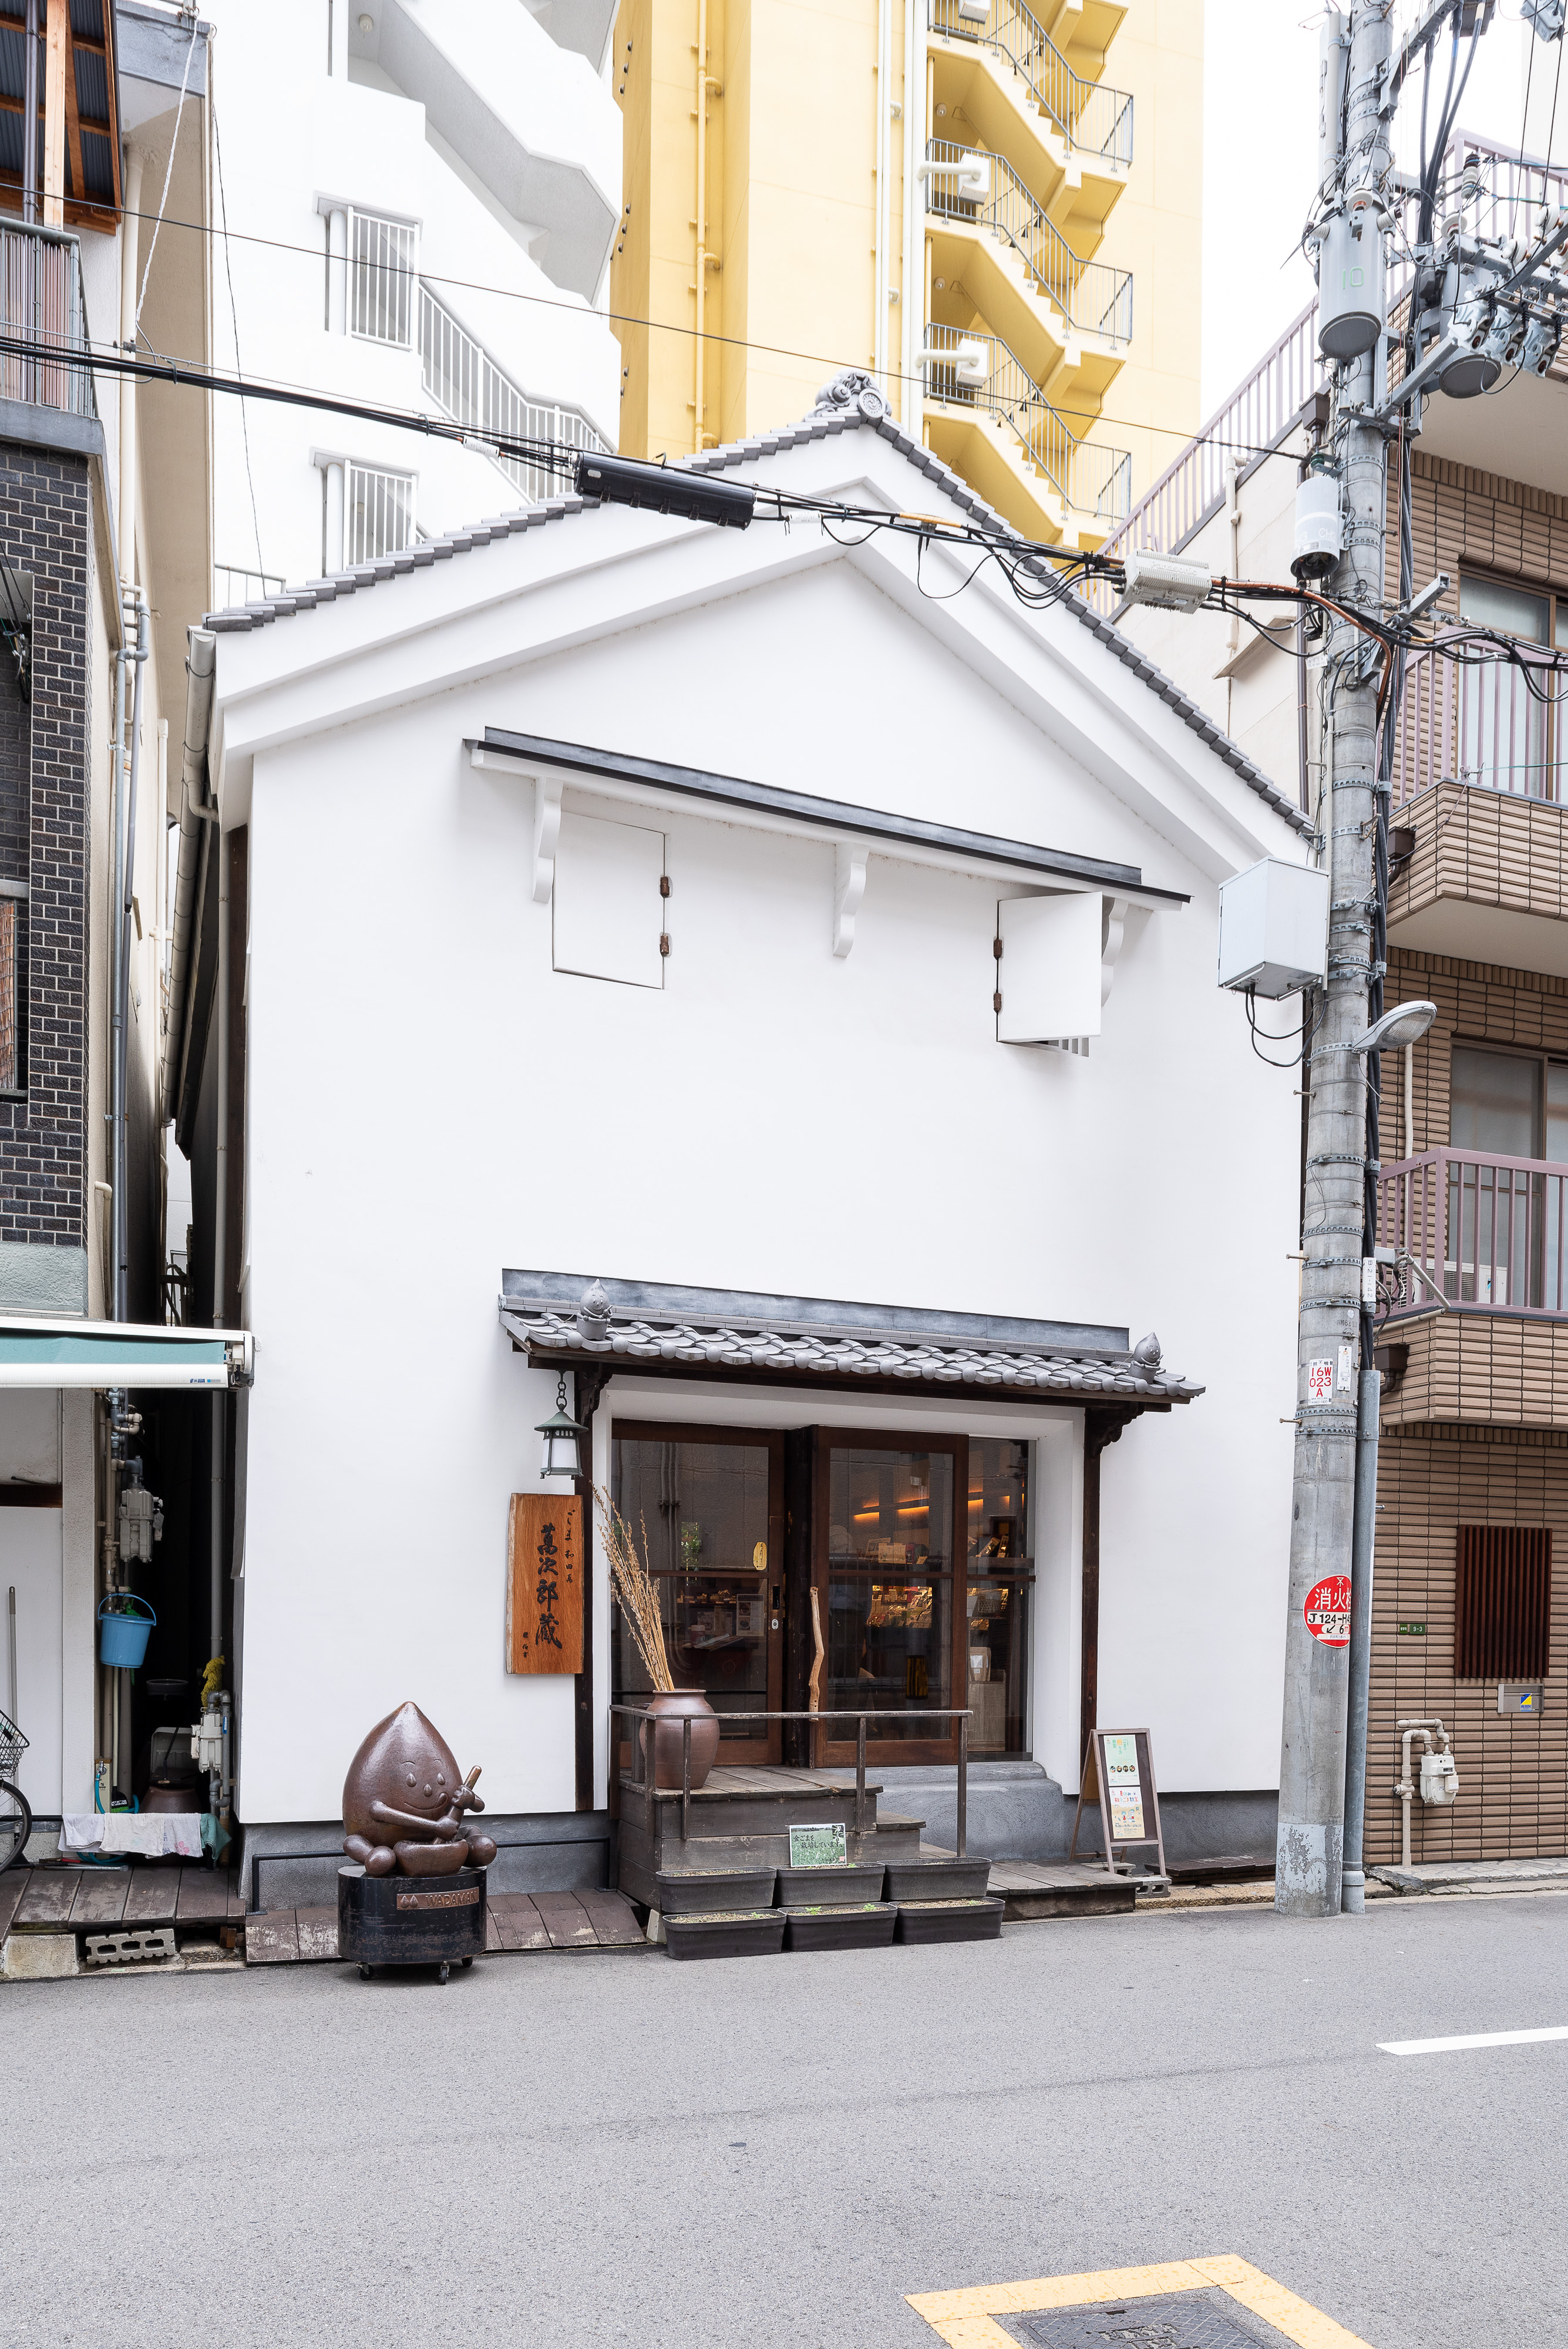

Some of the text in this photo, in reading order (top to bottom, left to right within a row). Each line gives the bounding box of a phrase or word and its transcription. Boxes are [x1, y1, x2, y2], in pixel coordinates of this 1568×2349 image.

[1342, 266, 1364, 290] 10
[1318, 527, 1336, 543] CH3
[1150, 561, 1197, 576] Panasonic
[1311, 1367, 1332, 1377] 16W
[1310, 1377, 1331, 1387] 023
[1316, 1388, 1323, 1397] A
[564, 1509, 576, 1541] ごま
[535, 1522, 563, 1649] 萬次郎蔵
[1339, 1624, 1350, 1634] 6m
[425, 1890, 477, 1907] WADAMAN
